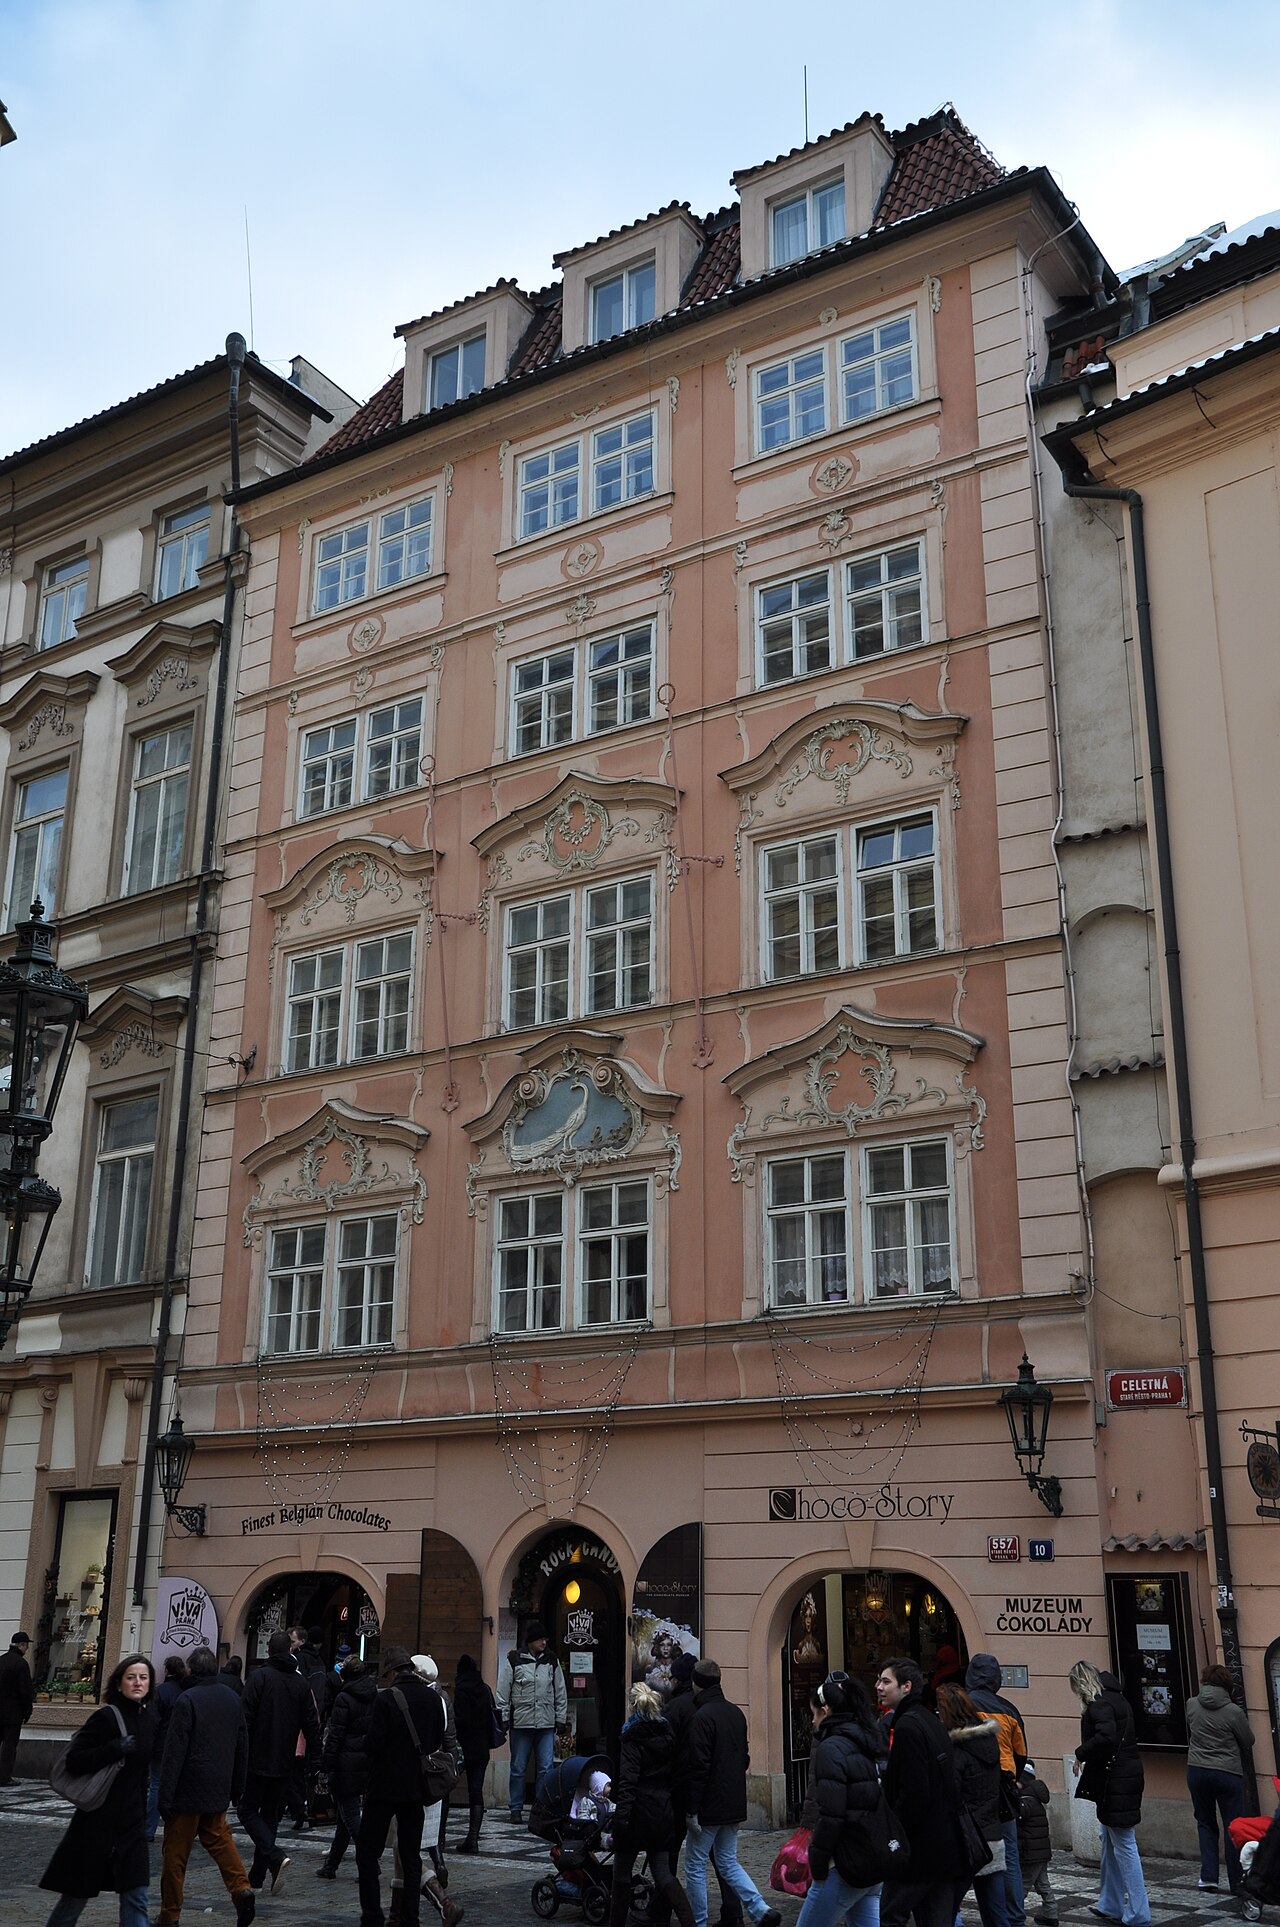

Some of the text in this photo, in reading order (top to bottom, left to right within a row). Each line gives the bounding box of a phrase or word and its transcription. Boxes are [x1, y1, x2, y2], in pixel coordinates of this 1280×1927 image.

[1121, 1376, 1169, 1391] CELETNÁ
[1120, 1393, 1134, 1401] STARÉ
[769, 1485, 955, 1525] Choco-Story
[241, 1503, 392, 1536] Finest Belgian Chocolates
[992, 1538, 1013, 1549] 557
[1034, 1544, 1046, 1556] 10
[540, 1541, 573, 1577] ROCK
[1005, 1598, 1083, 1613] MUZEUM
[996, 1614, 1093, 1633] ČOKOLÁDY
